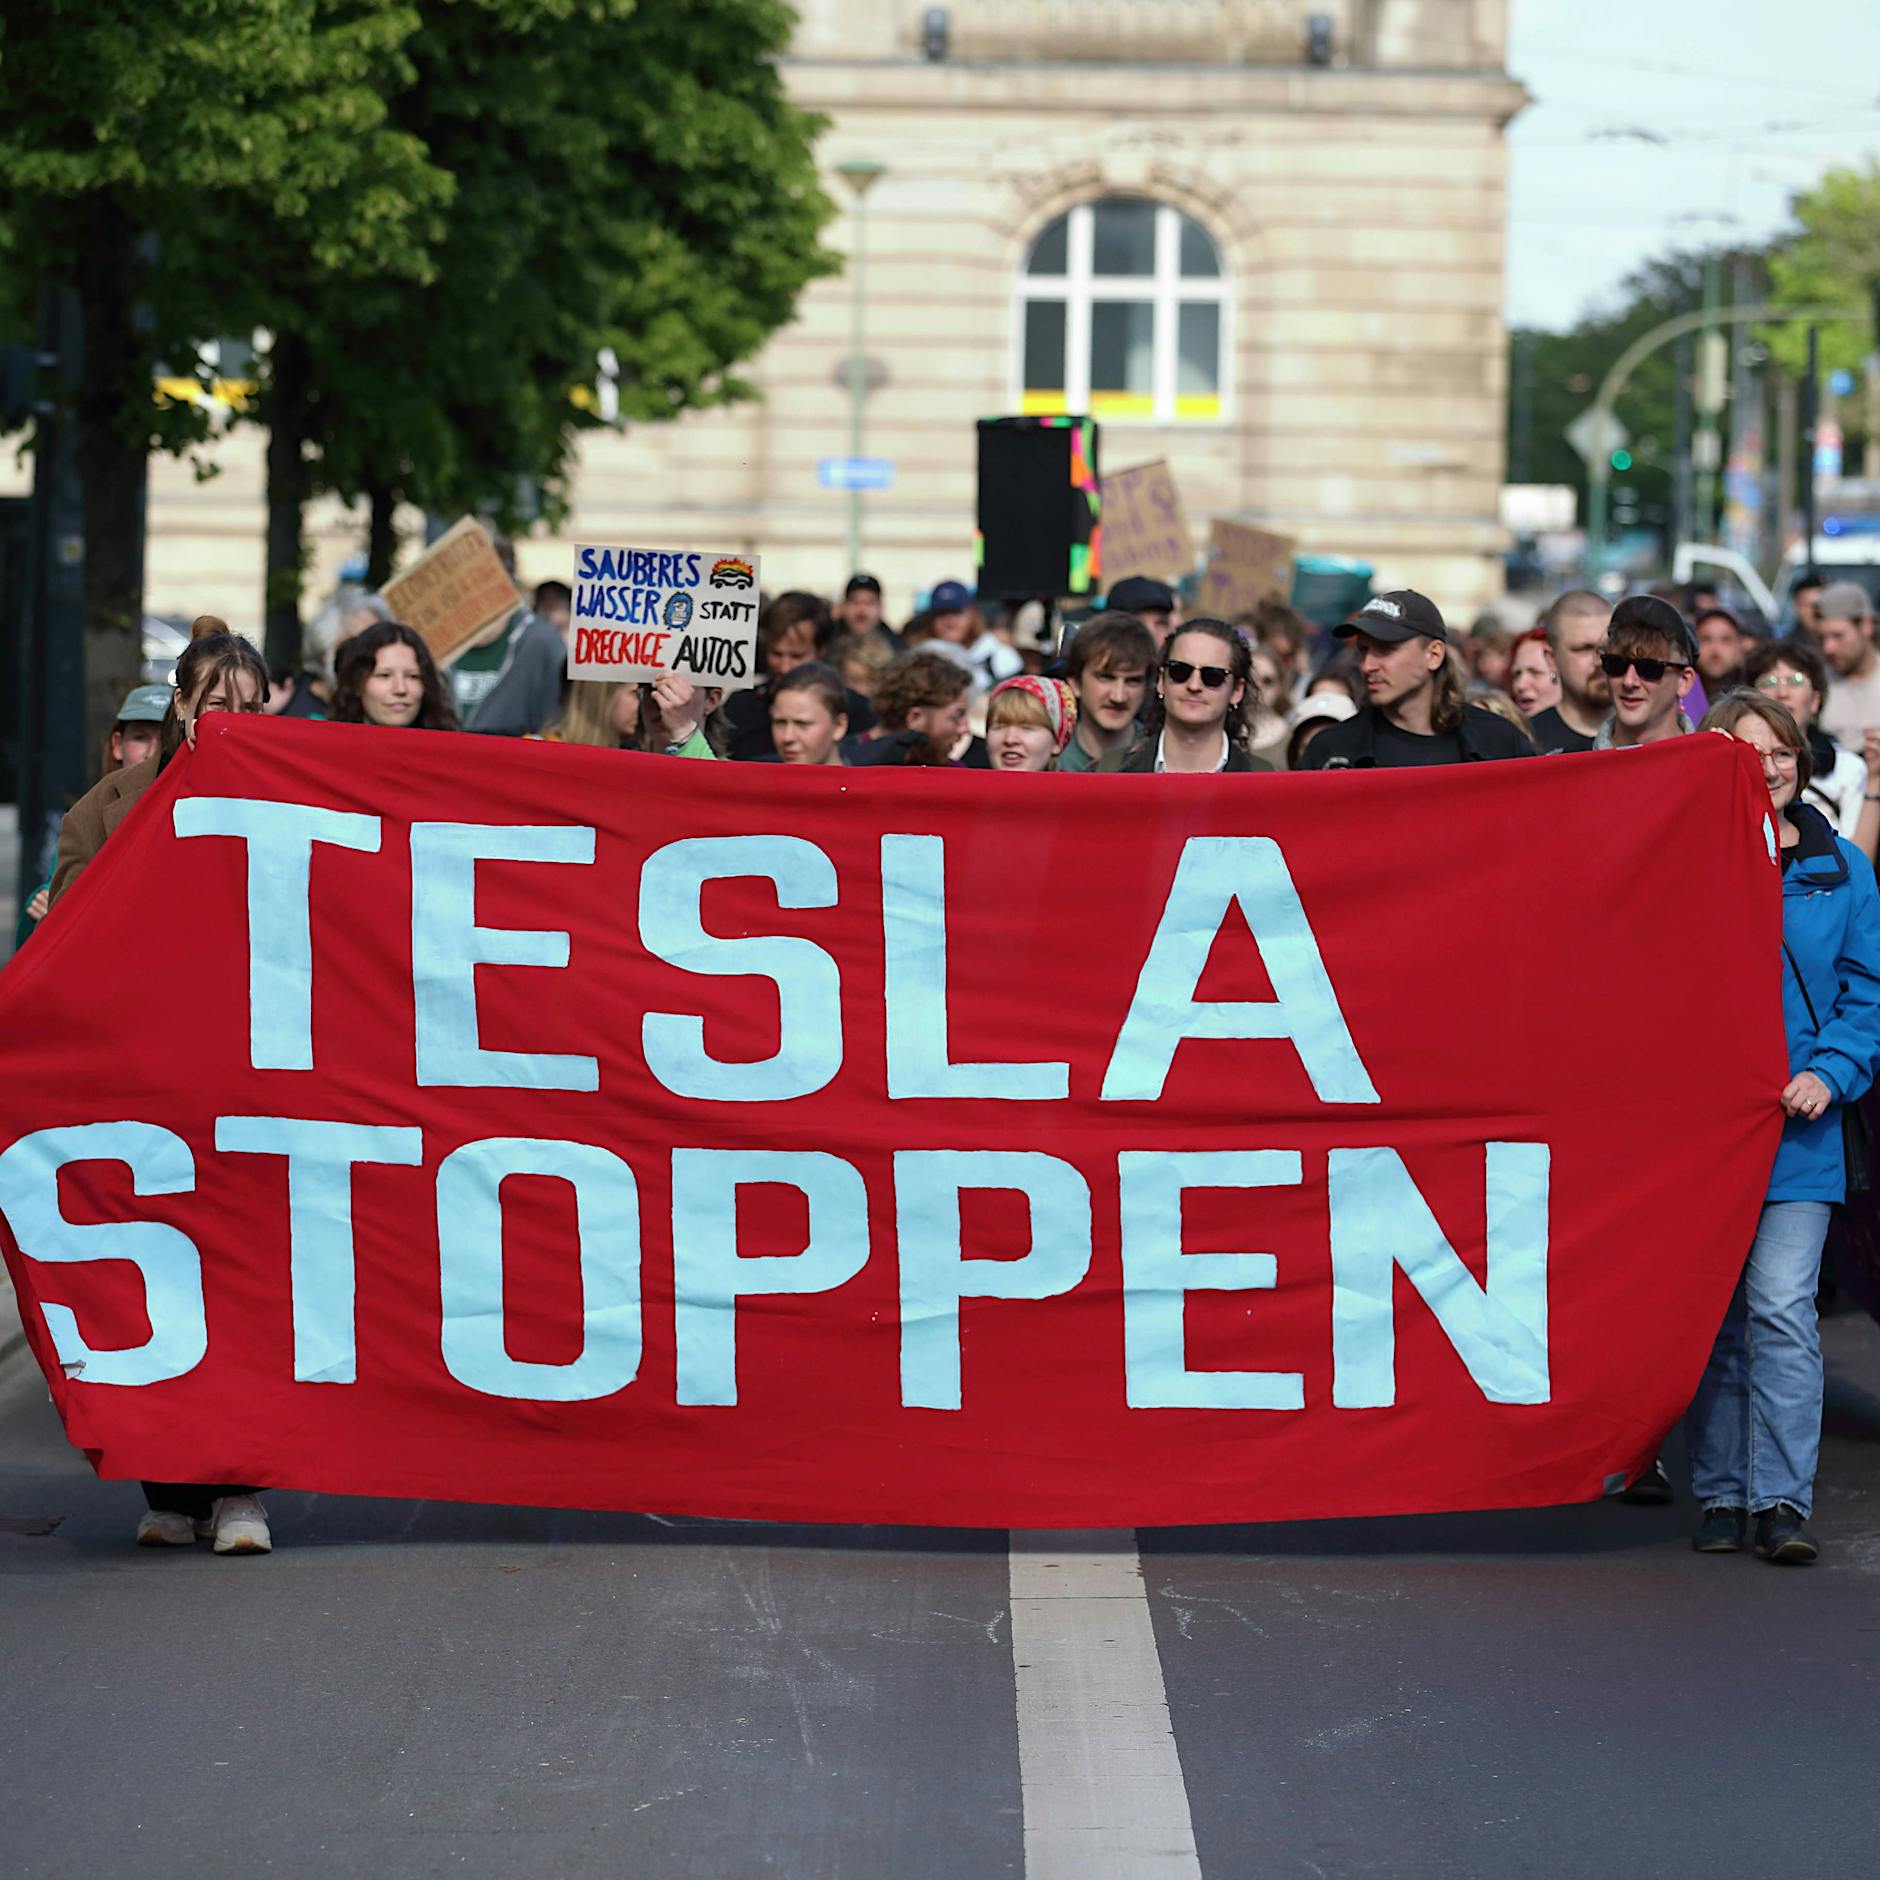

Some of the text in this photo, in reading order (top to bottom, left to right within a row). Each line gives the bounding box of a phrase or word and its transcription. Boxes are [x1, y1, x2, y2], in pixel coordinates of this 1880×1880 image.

[578, 548, 702, 589] SAUBERES
[576, 584, 756, 625] WASSER STATT
[575, 627, 749, 678] DRECKIGE AUTOS
[173, 797, 1382, 1104] TESLA
[0, 1116, 1551, 1409] STOPPEN
